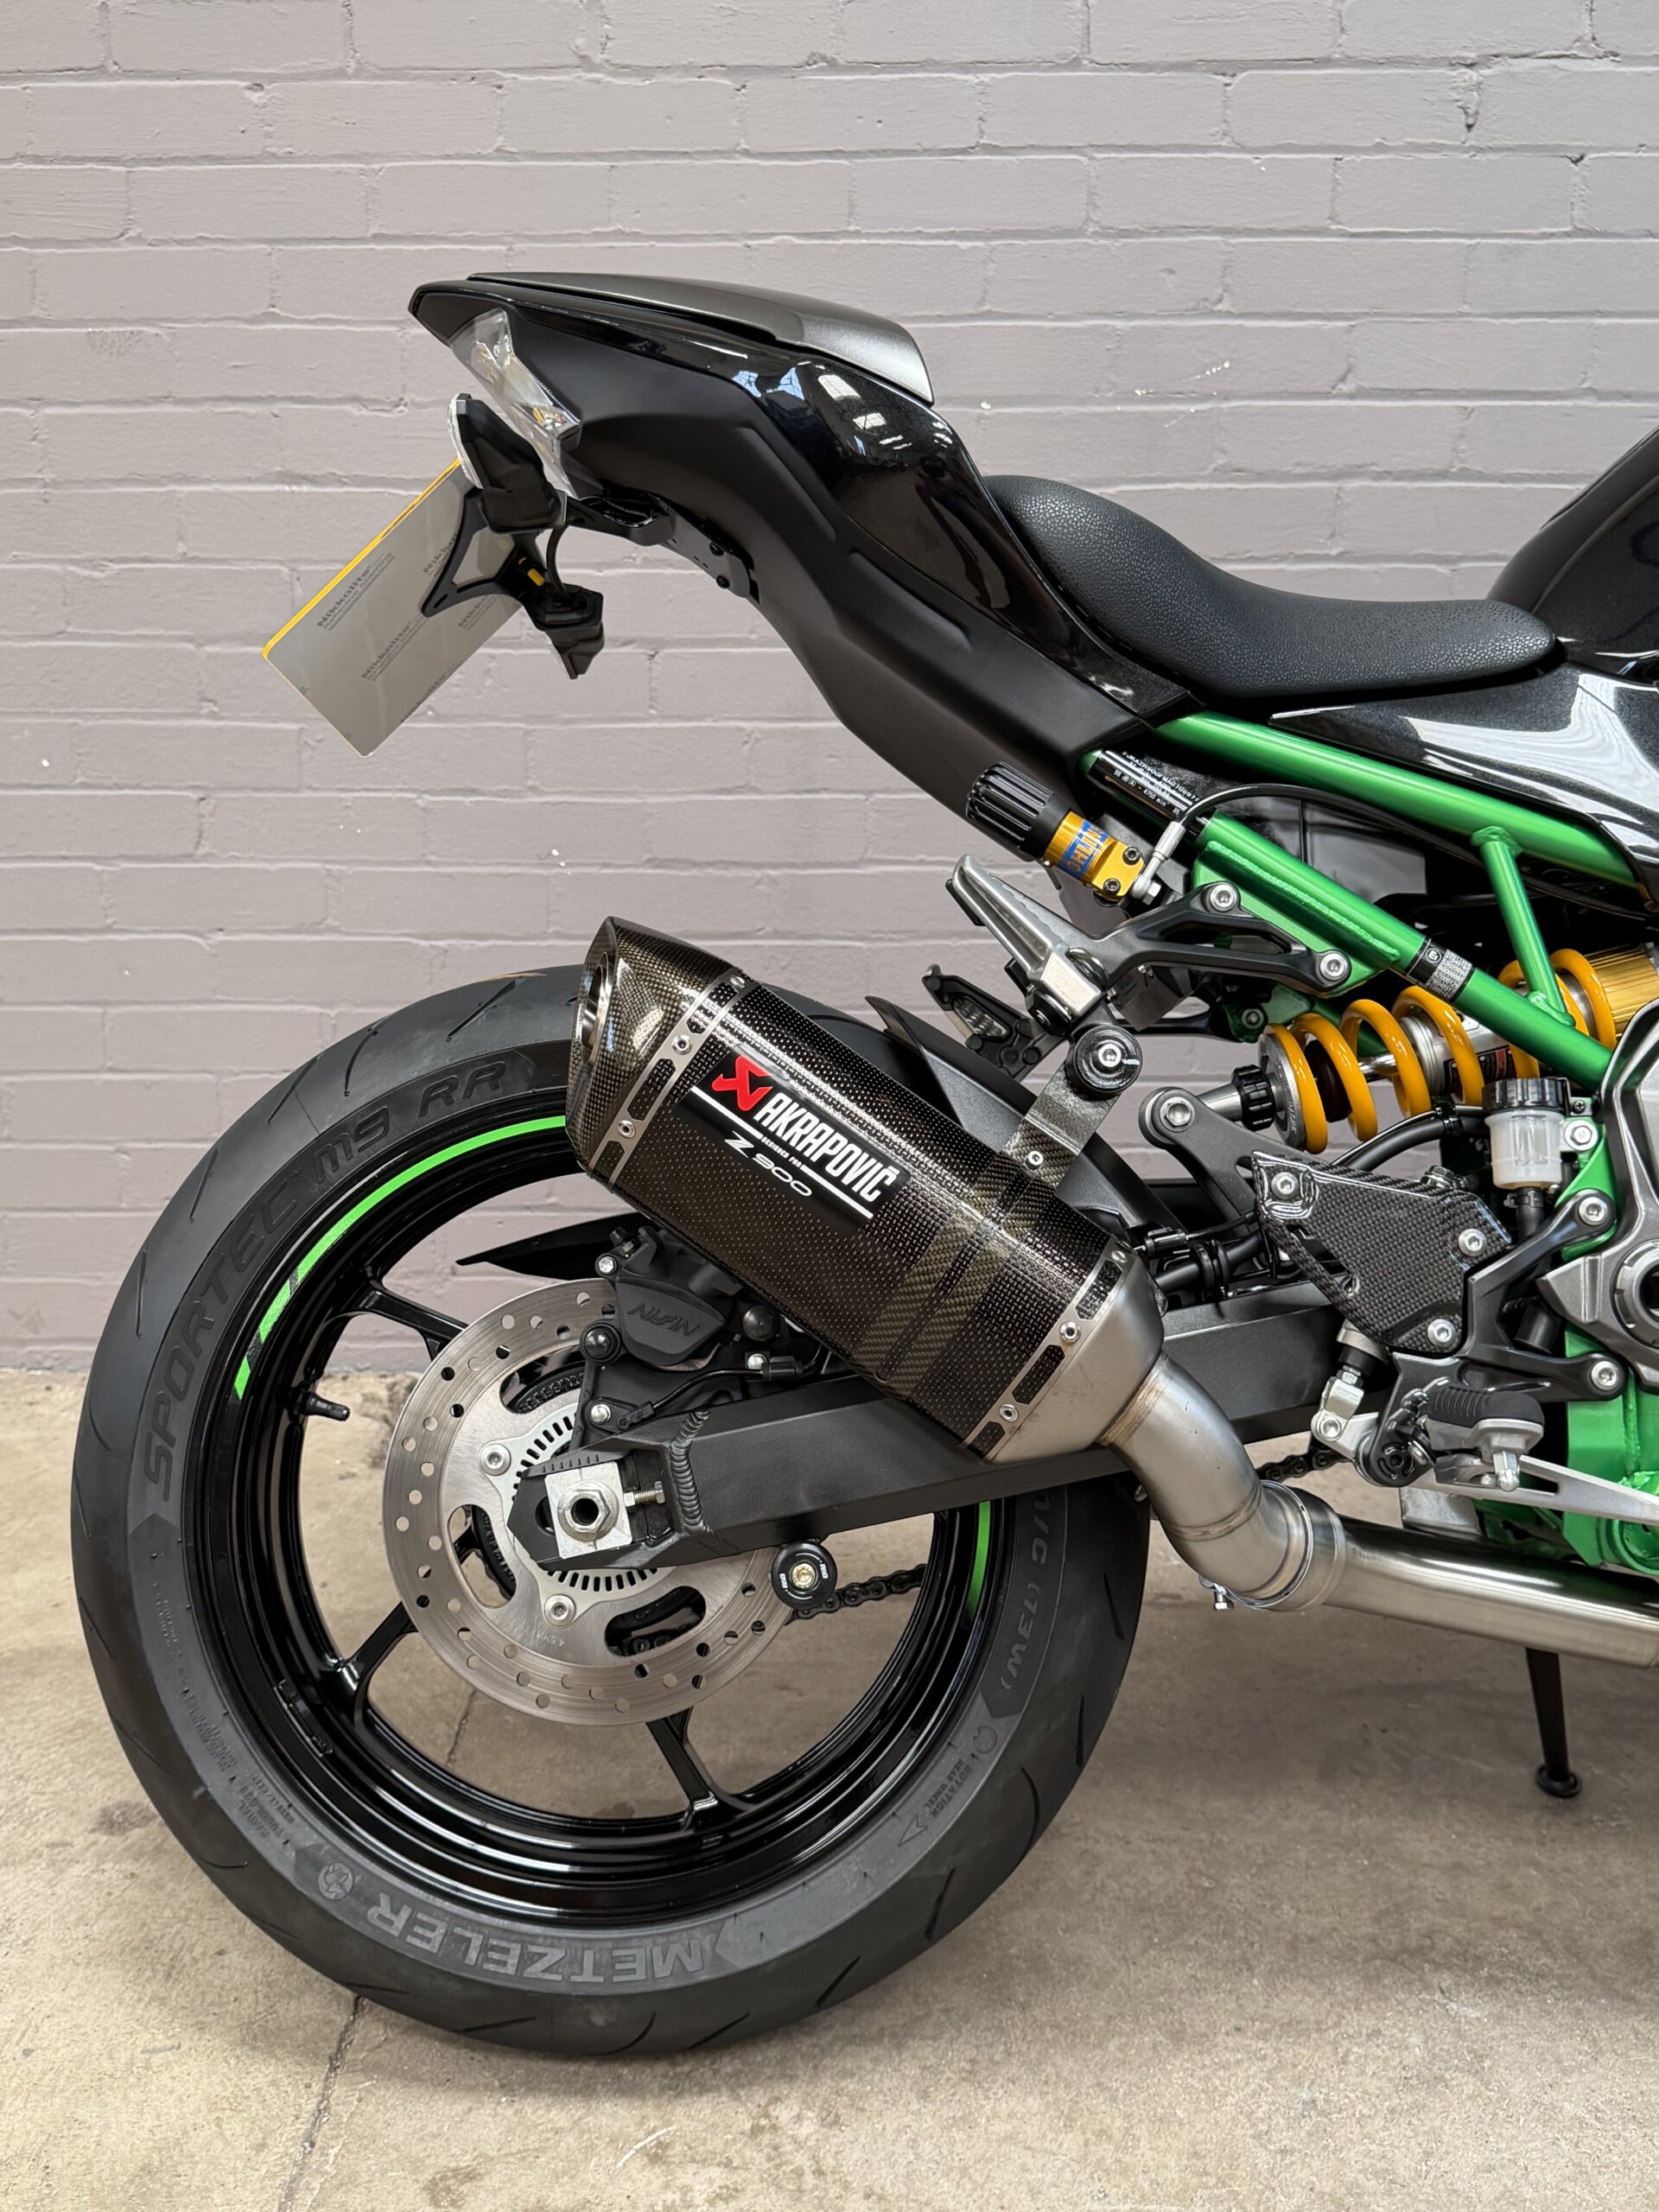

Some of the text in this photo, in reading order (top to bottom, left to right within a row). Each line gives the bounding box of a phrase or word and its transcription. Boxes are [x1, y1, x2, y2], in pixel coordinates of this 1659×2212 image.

[627, 1302, 700, 1337] NISSIN
[924, 1758, 964, 1809] REAR WHEEL
[931, 1764, 973, 1818] ROTATION
[366, 1891, 705, 1983] METZELER
